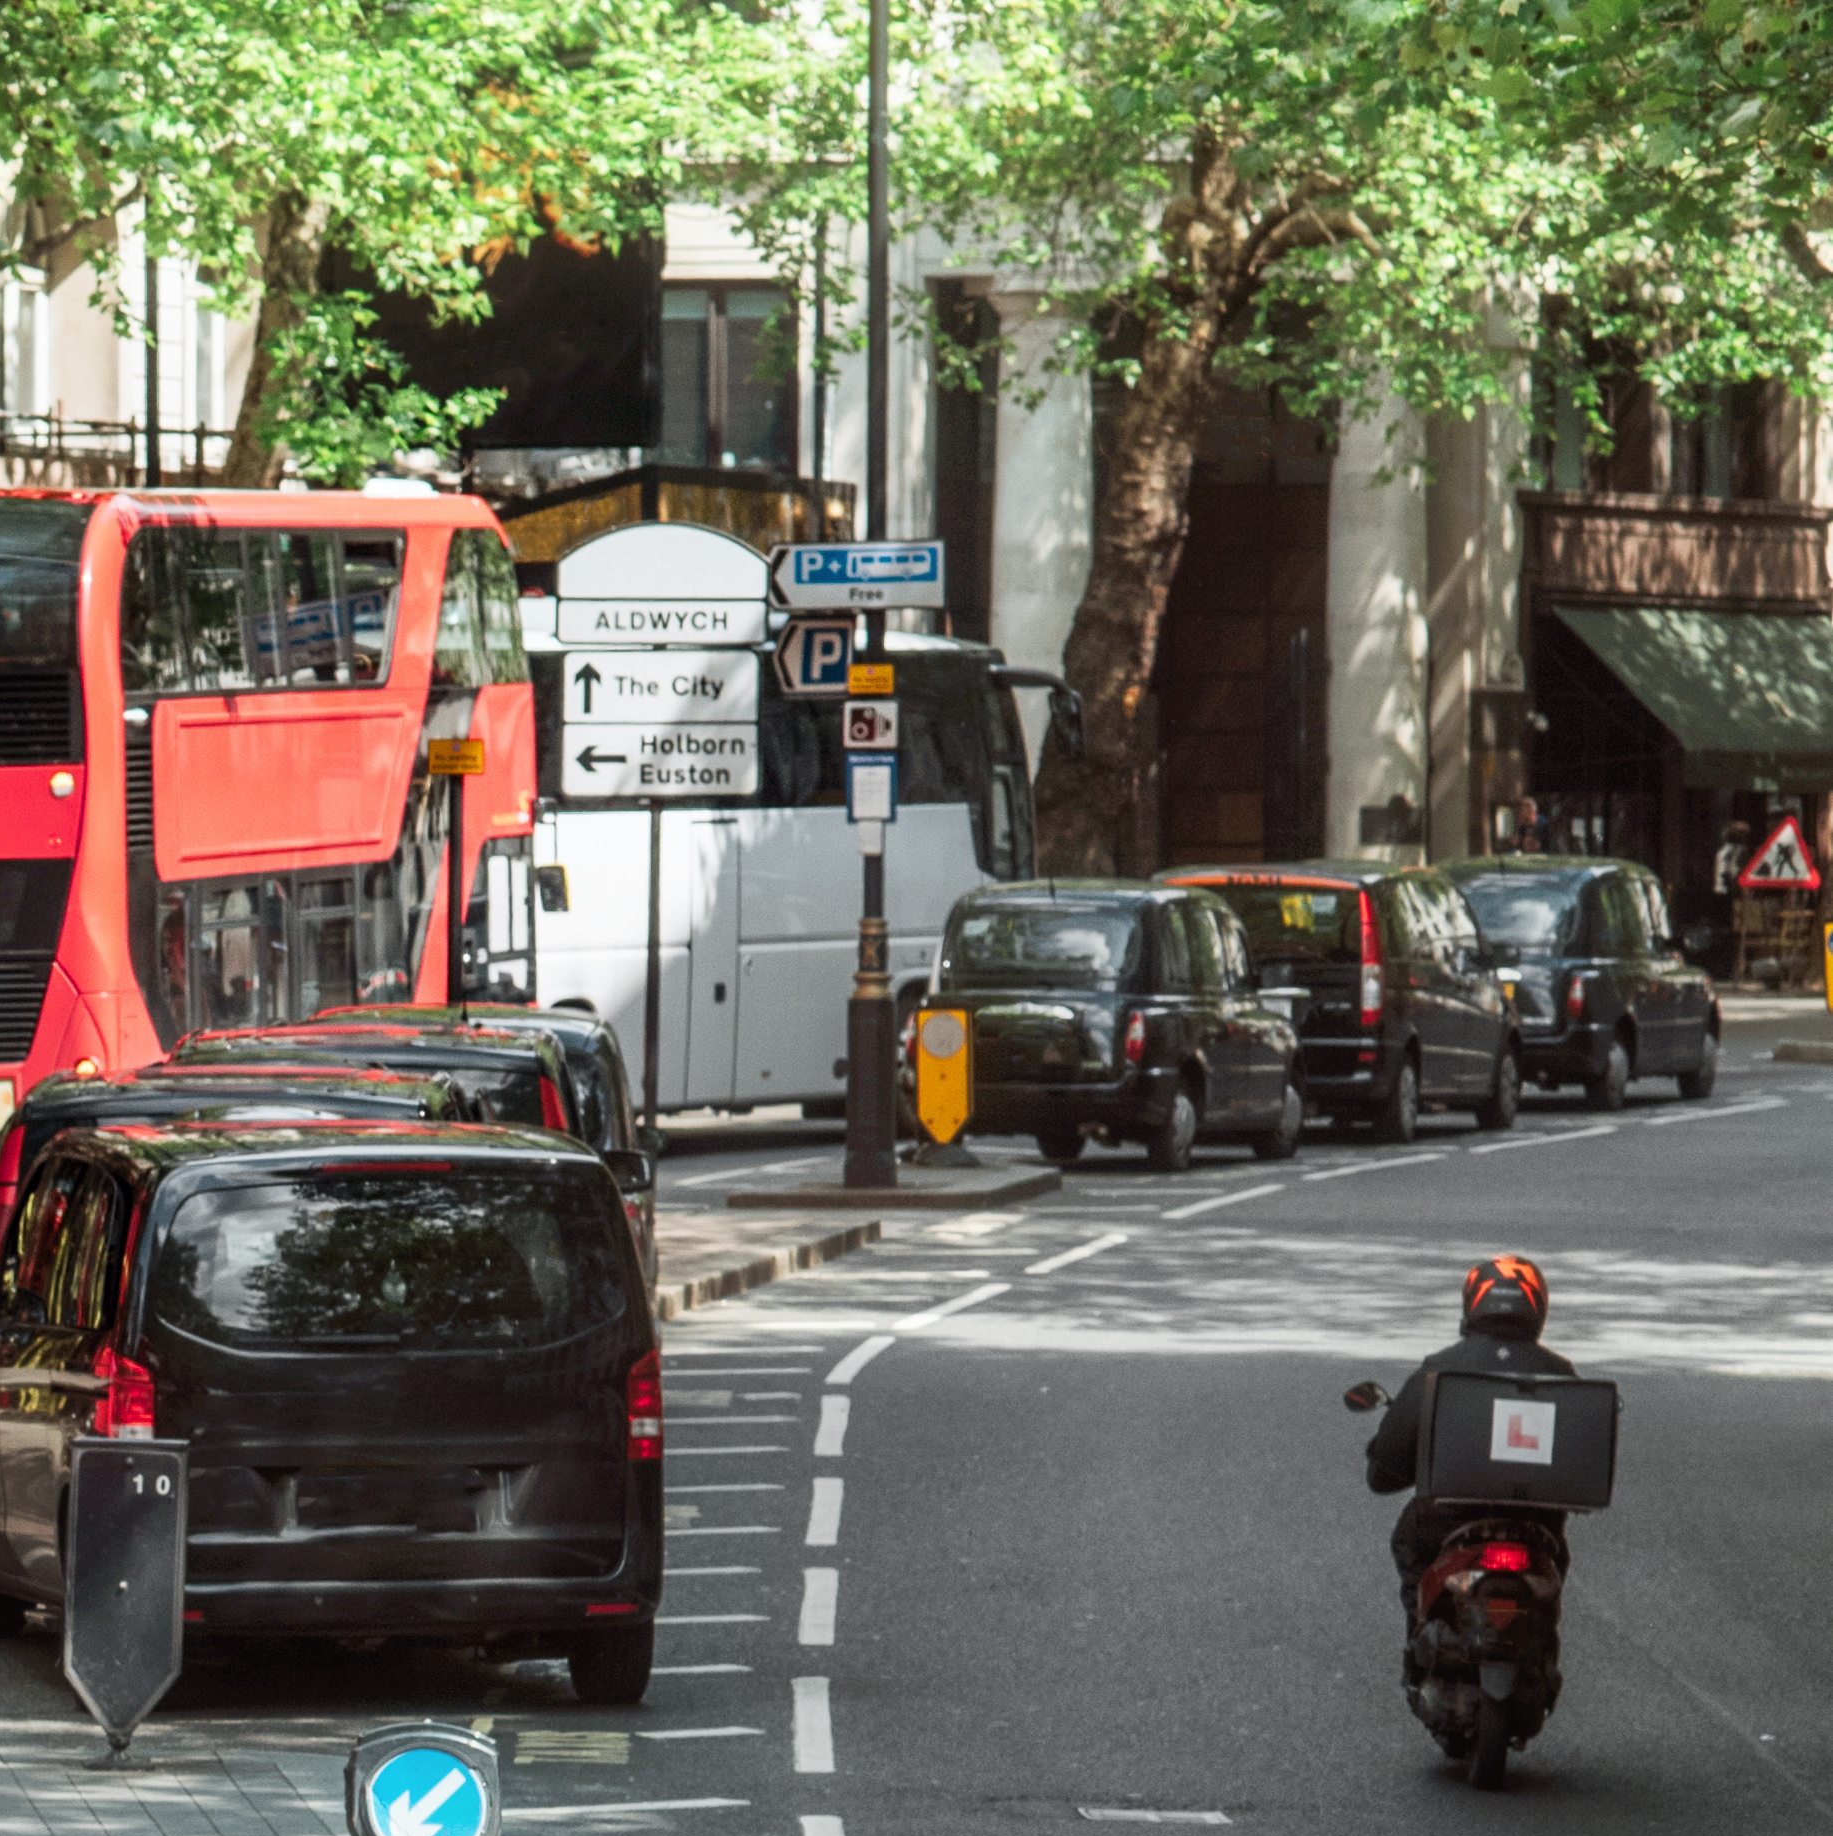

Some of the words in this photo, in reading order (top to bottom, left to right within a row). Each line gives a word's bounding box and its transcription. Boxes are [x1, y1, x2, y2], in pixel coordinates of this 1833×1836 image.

[849, 587, 884, 601] Free
[595, 611, 728, 631] ALDWYCH
[810, 631, 843, 681] P
[614, 675, 659, 696] The
[671, 675, 725, 700] City
[640, 733, 746, 755] Holborn
[640, 763, 731, 785] Euston
[1507, 1413, 1540, 1450] L
